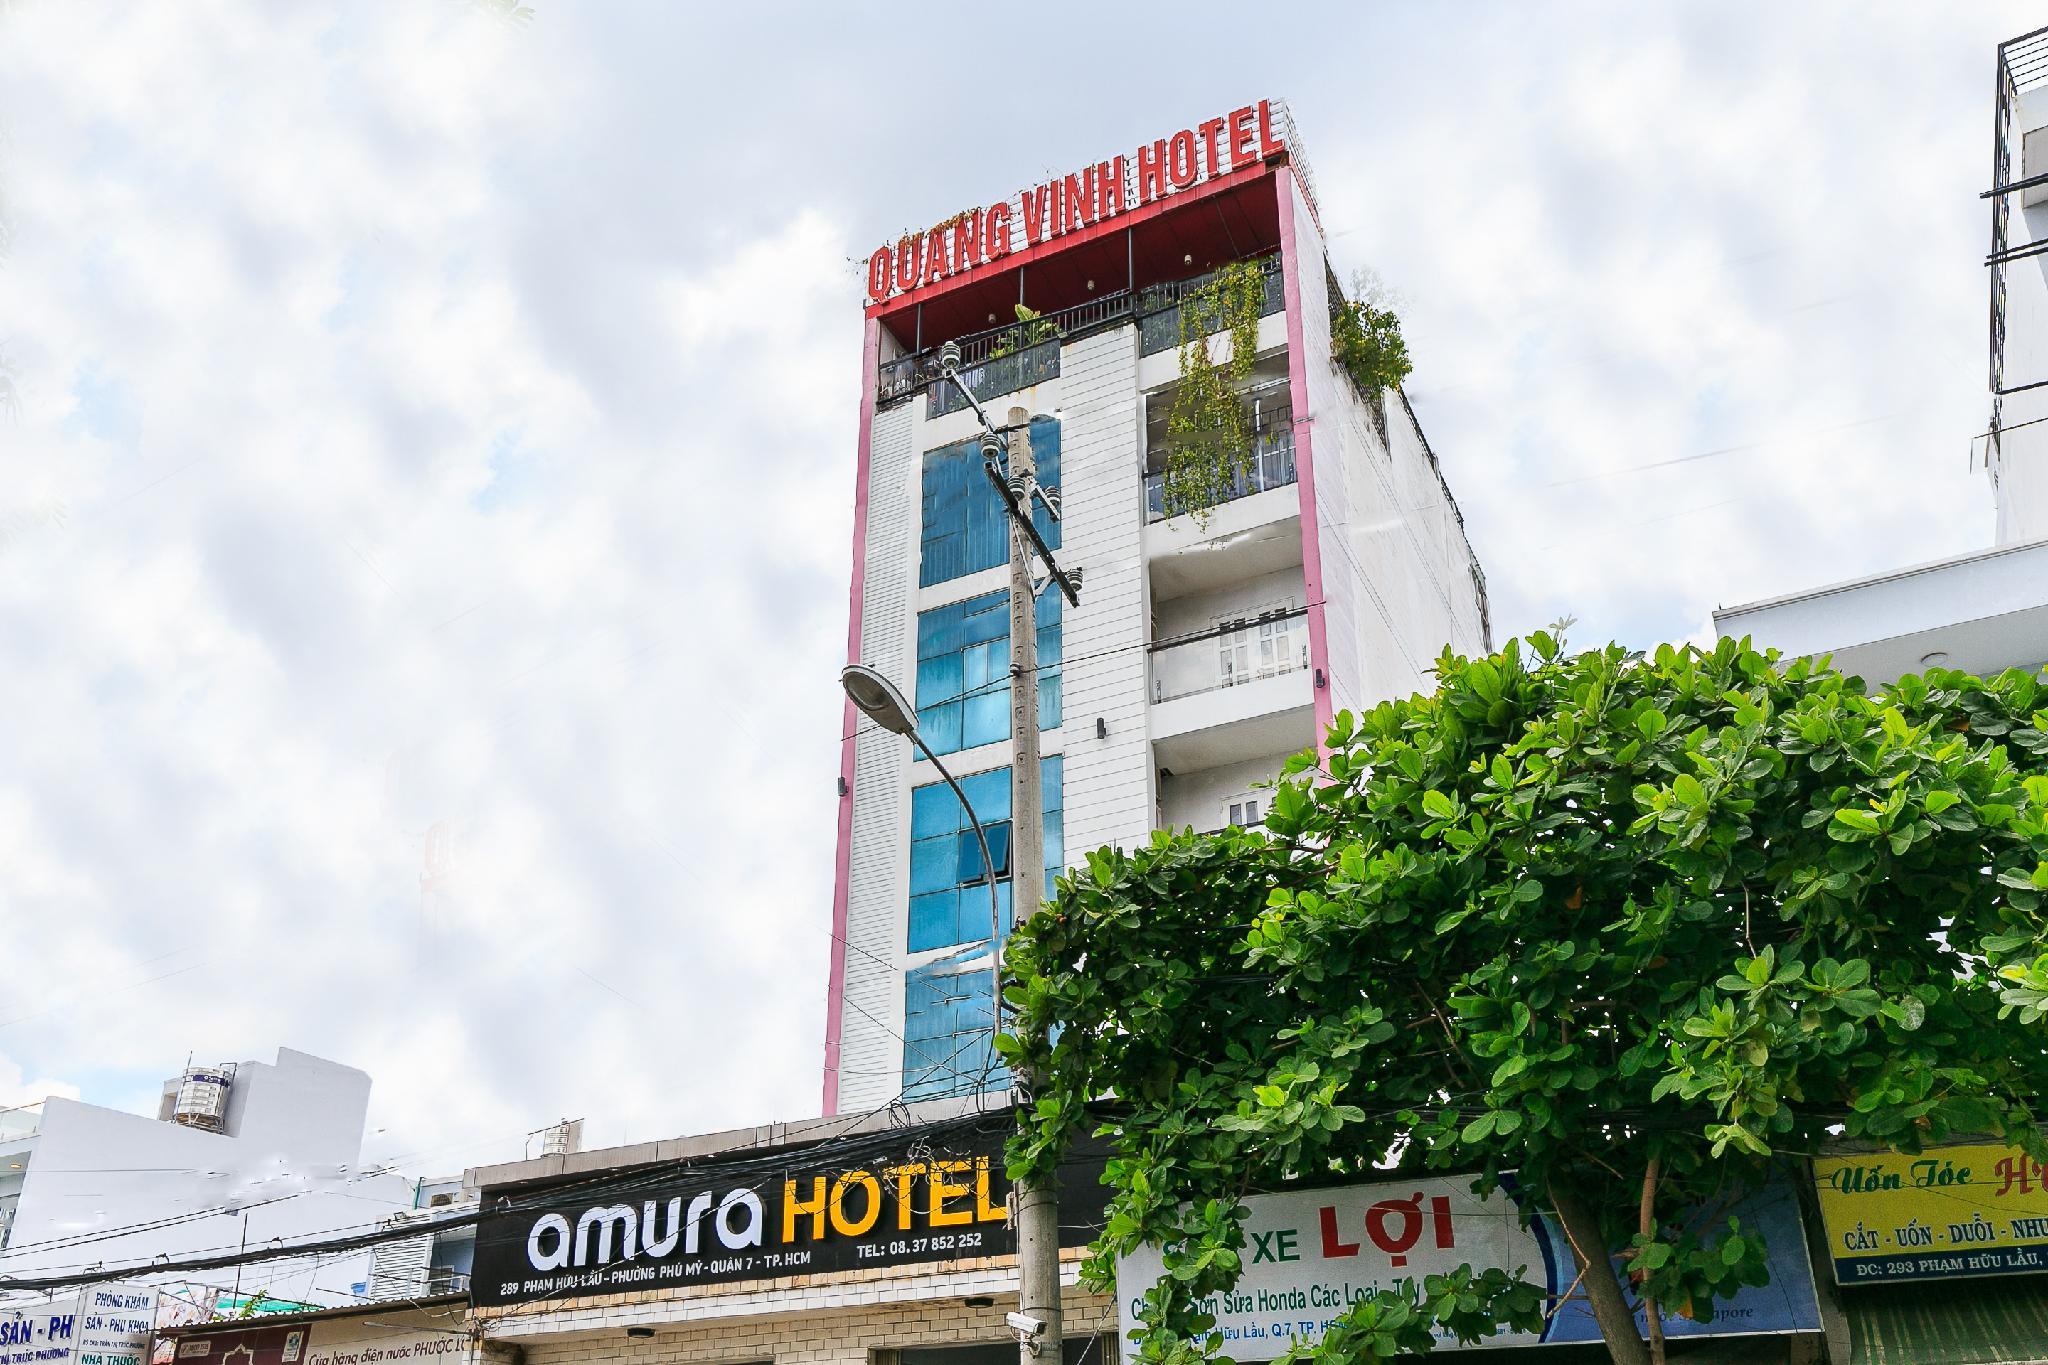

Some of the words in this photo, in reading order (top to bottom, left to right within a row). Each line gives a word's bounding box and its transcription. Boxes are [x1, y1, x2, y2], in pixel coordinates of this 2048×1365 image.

[868, 203, 1012, 304] QUANG
[1021, 155, 1126, 245] VINH
[1138, 98, 1286, 202] HOTEL
[527, 1187, 763, 1271] amura
[782, 1156, 1007, 1243] HOTEL
[1251, 1229, 1300, 1264] XE
[1319, 1191, 1455, 1267] LỢI
[1844, 1222, 1880, 1250] CẮT
[1894, 1218, 1933, 1247] UỐN
[1948, 1213, 1996, 1243] DUỖI
[857, 1244, 885, 1258] TEL:
[931, 1236, 955, 1251] 852
[958, 1232, 982, 1247] 252
[1888, 1262, 1914, 1274] 293
[1918, 1258, 1964, 1274] PHẠM
[1968, 1253, 2001, 1269] HỮU
[500, 1282, 519, 1296] 289
[523, 1279, 553, 1294] PHẠM
[611, 1265, 655, 1283] PHƯỜNG
[659, 1261, 682, 1279] PHÚ
[710, 1256, 743, 1274] QUẬN
[746, 1257, 753, 1270] 7
[1223, 1290, 1254, 1315] Sửa
[1258, 1286, 1307, 1312] Honda
[1311, 1283, 1341, 1308] Các
[361, 1347, 384, 1365] điện
[386, 1345, 411, 1360] nước
[413, 1336, 453, 1356] PHƯỚC
